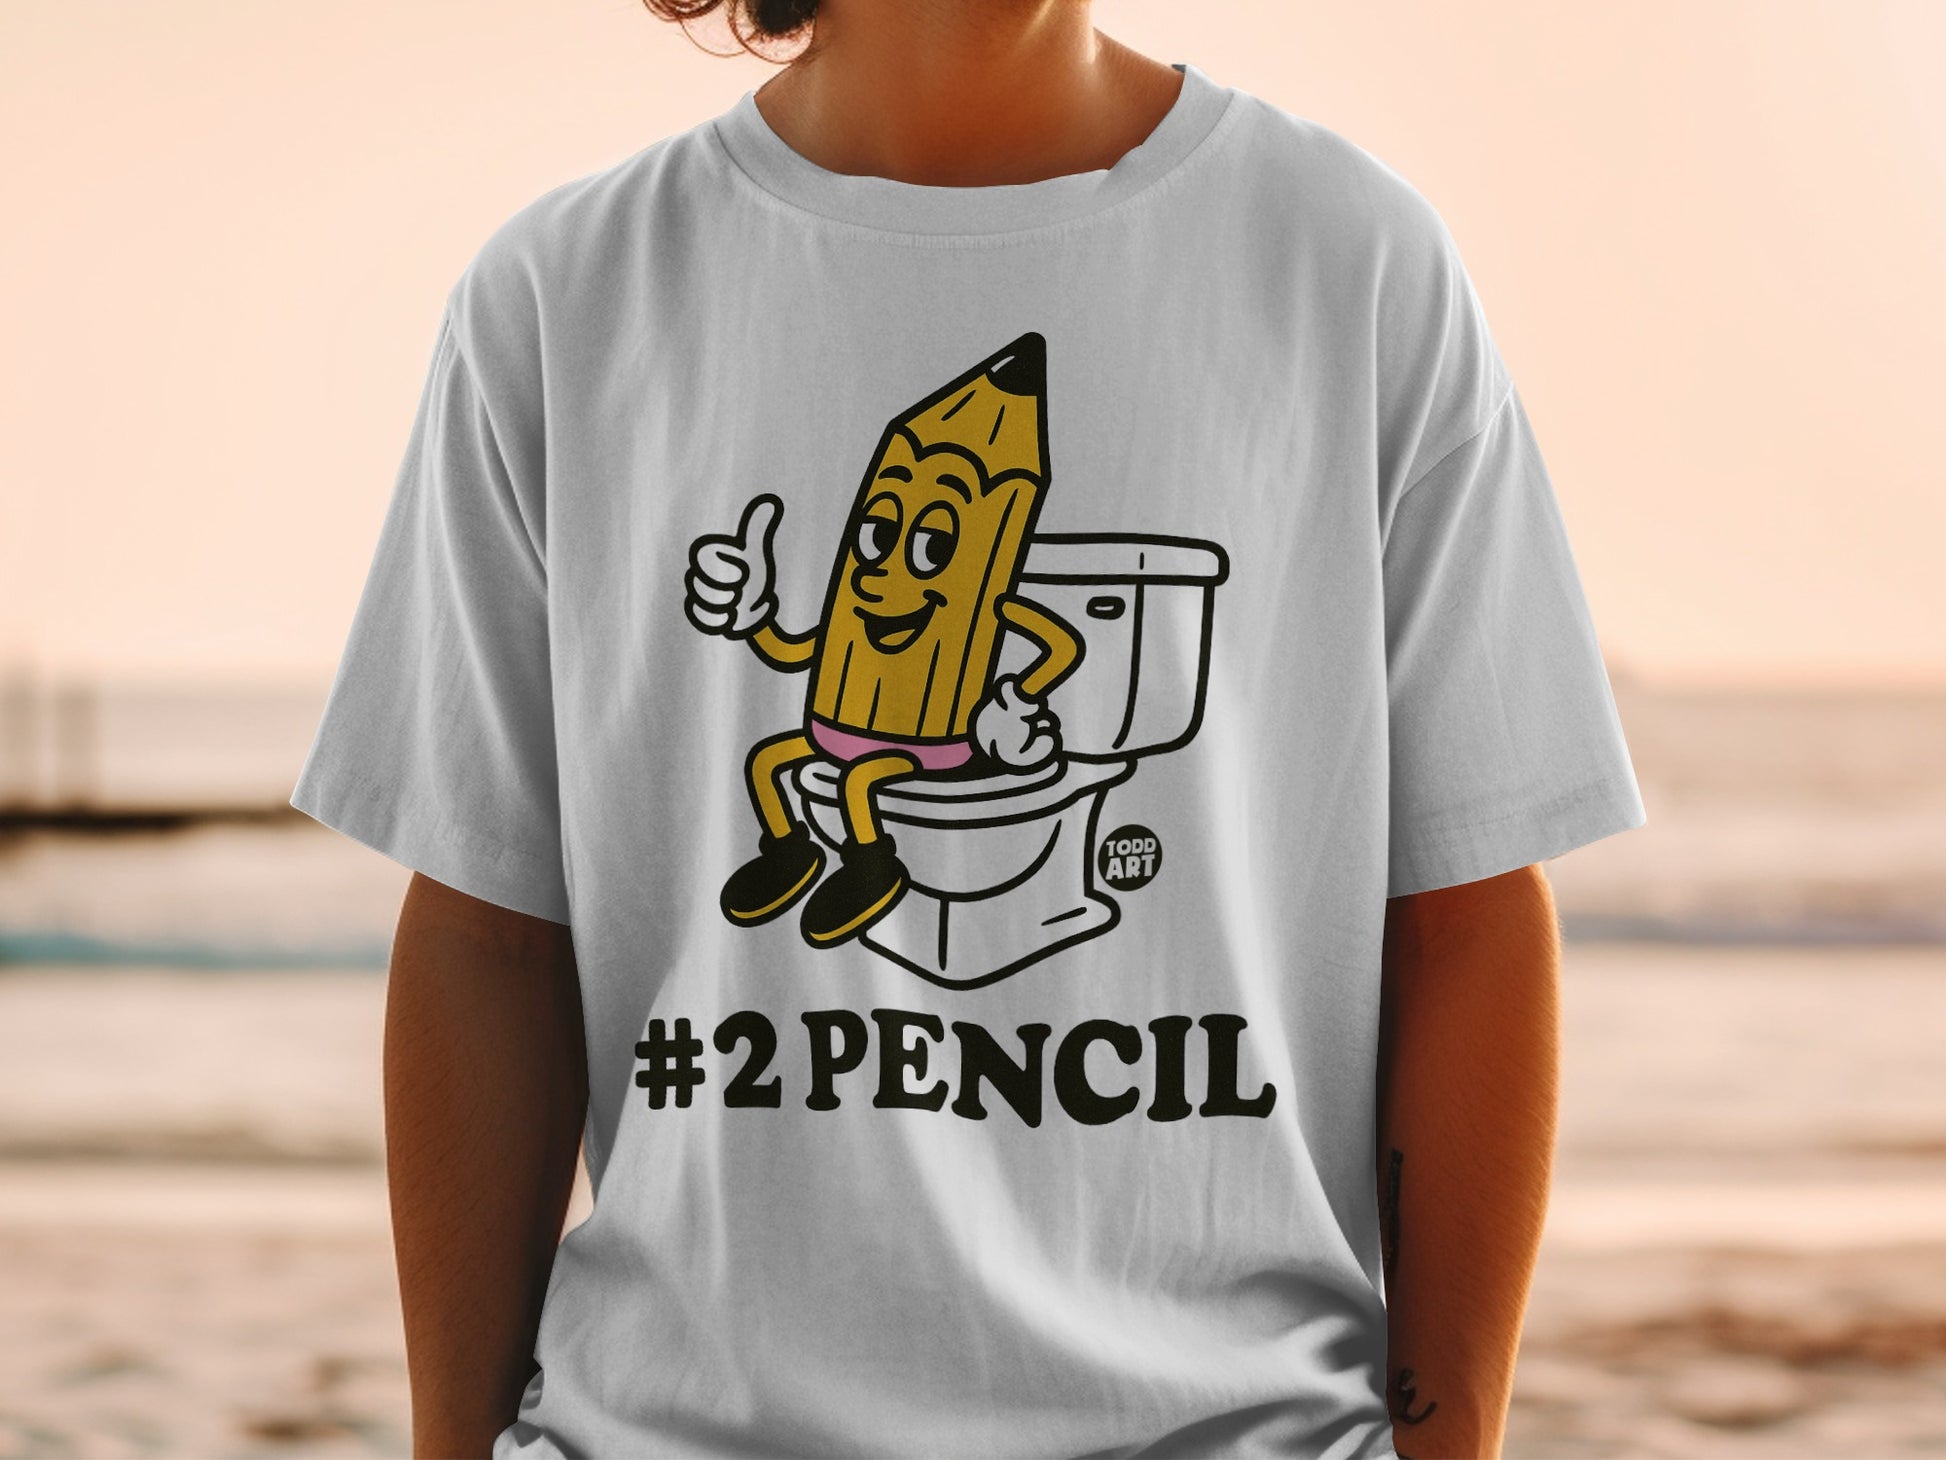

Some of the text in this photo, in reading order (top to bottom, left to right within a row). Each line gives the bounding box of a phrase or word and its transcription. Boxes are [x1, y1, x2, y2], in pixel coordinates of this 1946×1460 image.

[1106, 837, 1156, 857] TODD
[1105, 854, 1155, 880] ART
[634, 1009, 1277, 1128] #2 PENCIL
